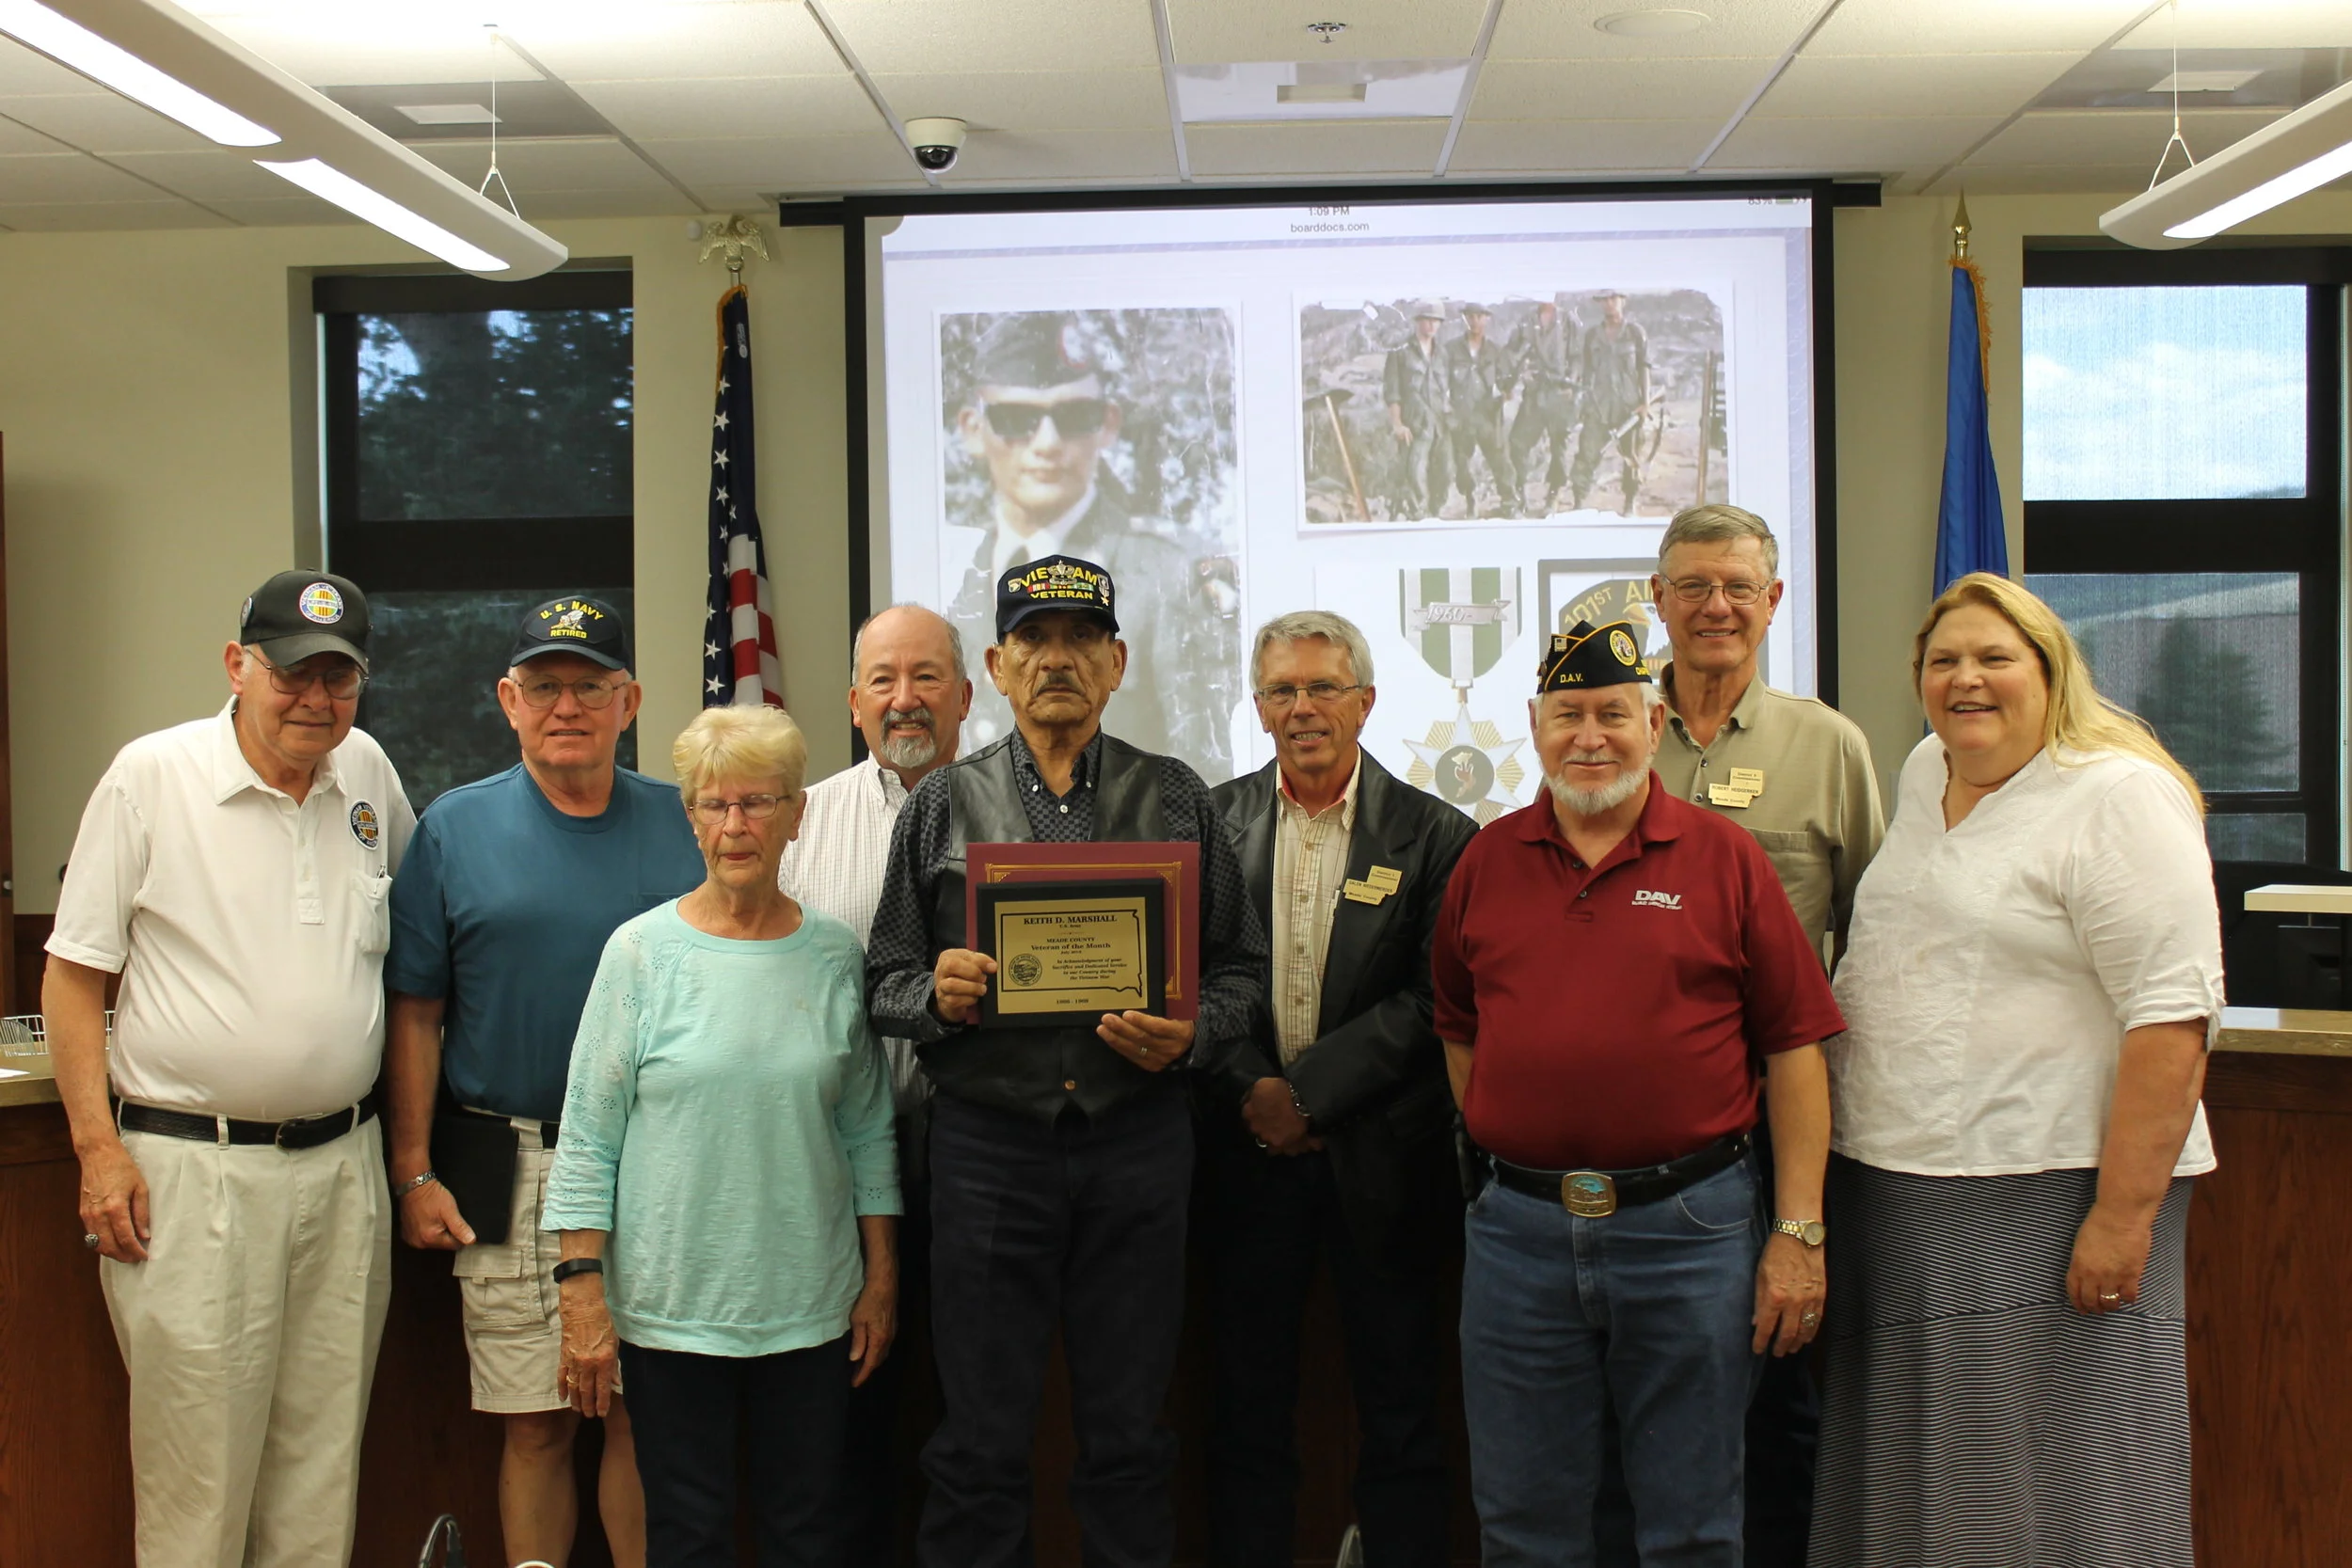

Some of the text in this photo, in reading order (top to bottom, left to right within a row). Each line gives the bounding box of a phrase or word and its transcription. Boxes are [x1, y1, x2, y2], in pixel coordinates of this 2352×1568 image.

[1309, 204, 1350, 216] 1:09 PM
[1290, 222, 1370, 233] boarddocs.com
[1021, 566, 1099, 587] VIEAM
[1030, 590, 1093, 600] VETERAN
[540, 601, 604, 620] U. S. NAVY
[550, 629, 588, 639] RETIRED
[1559, 673, 1584, 683] D.A.V.
[1635, 890, 1682, 905] DAV
[1067, 915, 1117, 924] MARSHALL
